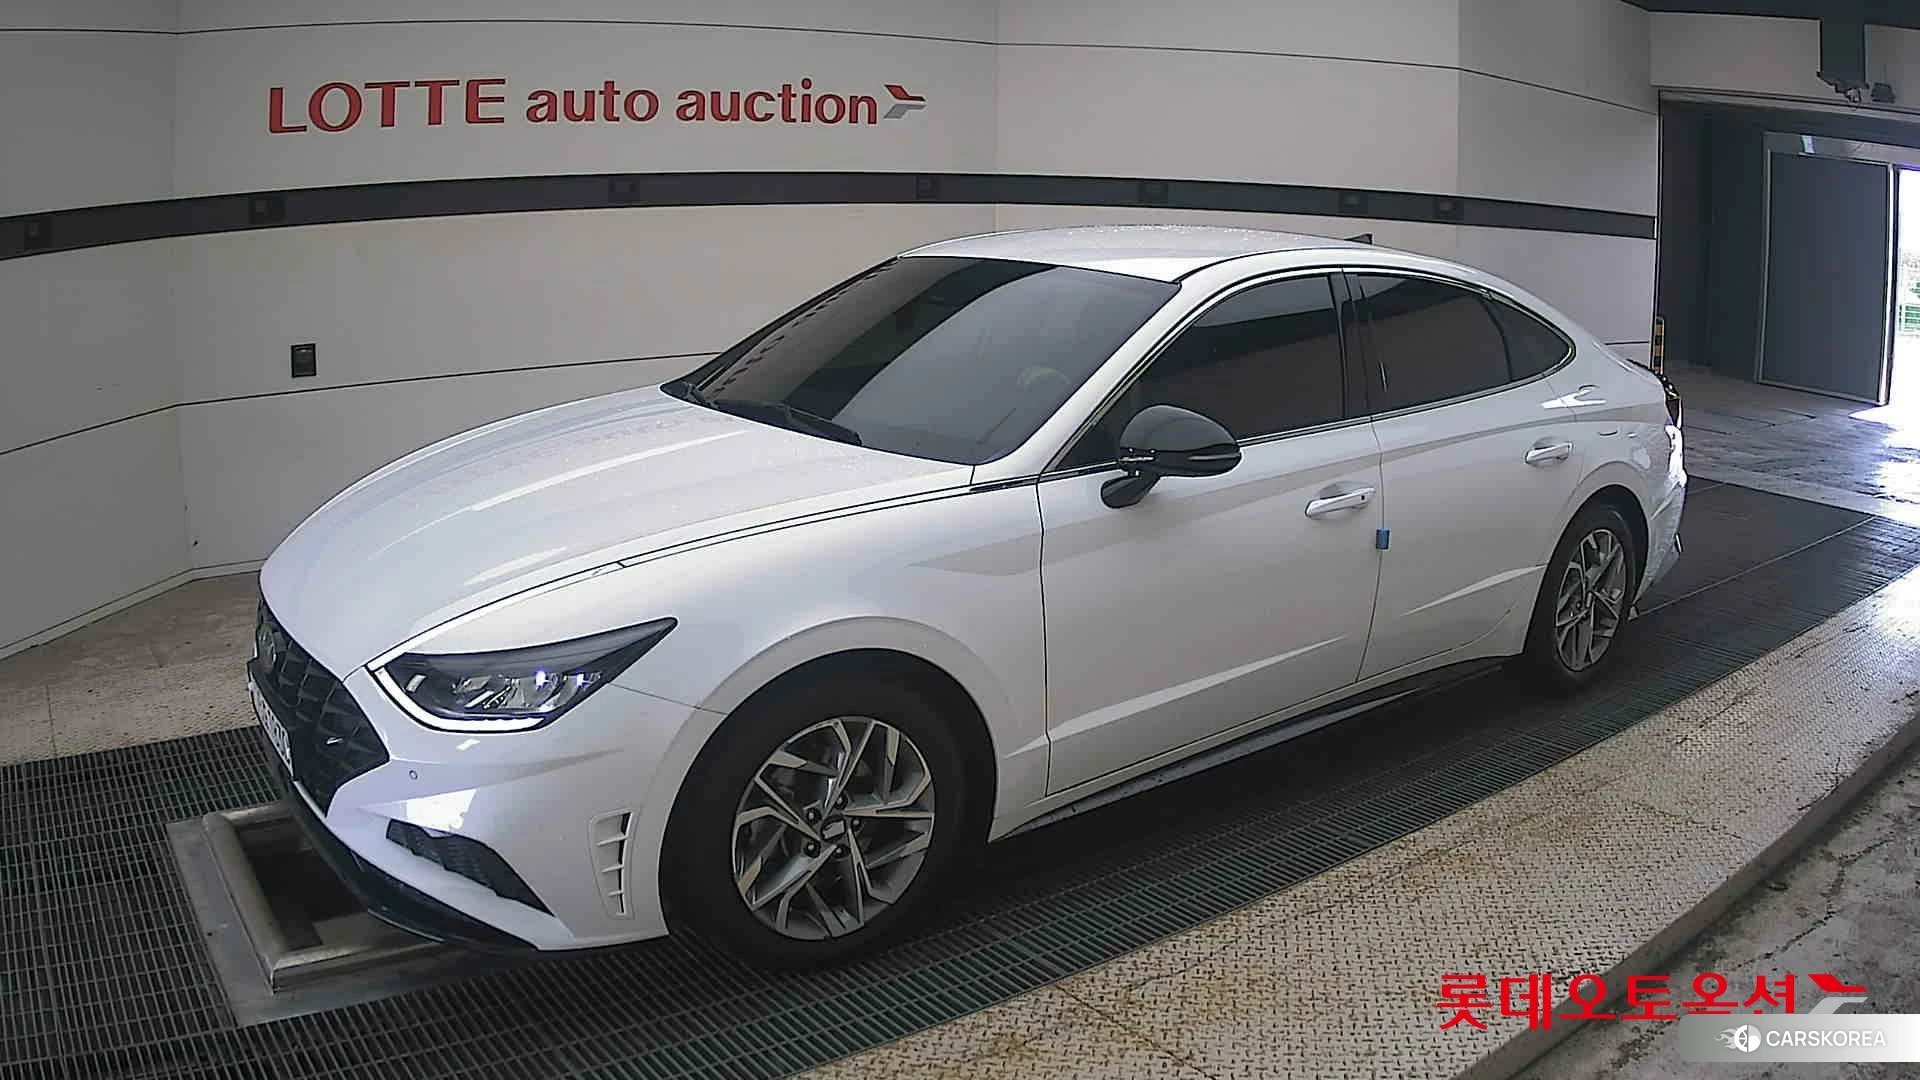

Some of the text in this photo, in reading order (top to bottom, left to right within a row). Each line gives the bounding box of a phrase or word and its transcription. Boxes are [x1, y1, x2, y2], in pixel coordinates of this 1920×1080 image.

[268, 79, 879, 134] LOTTE auto auction
